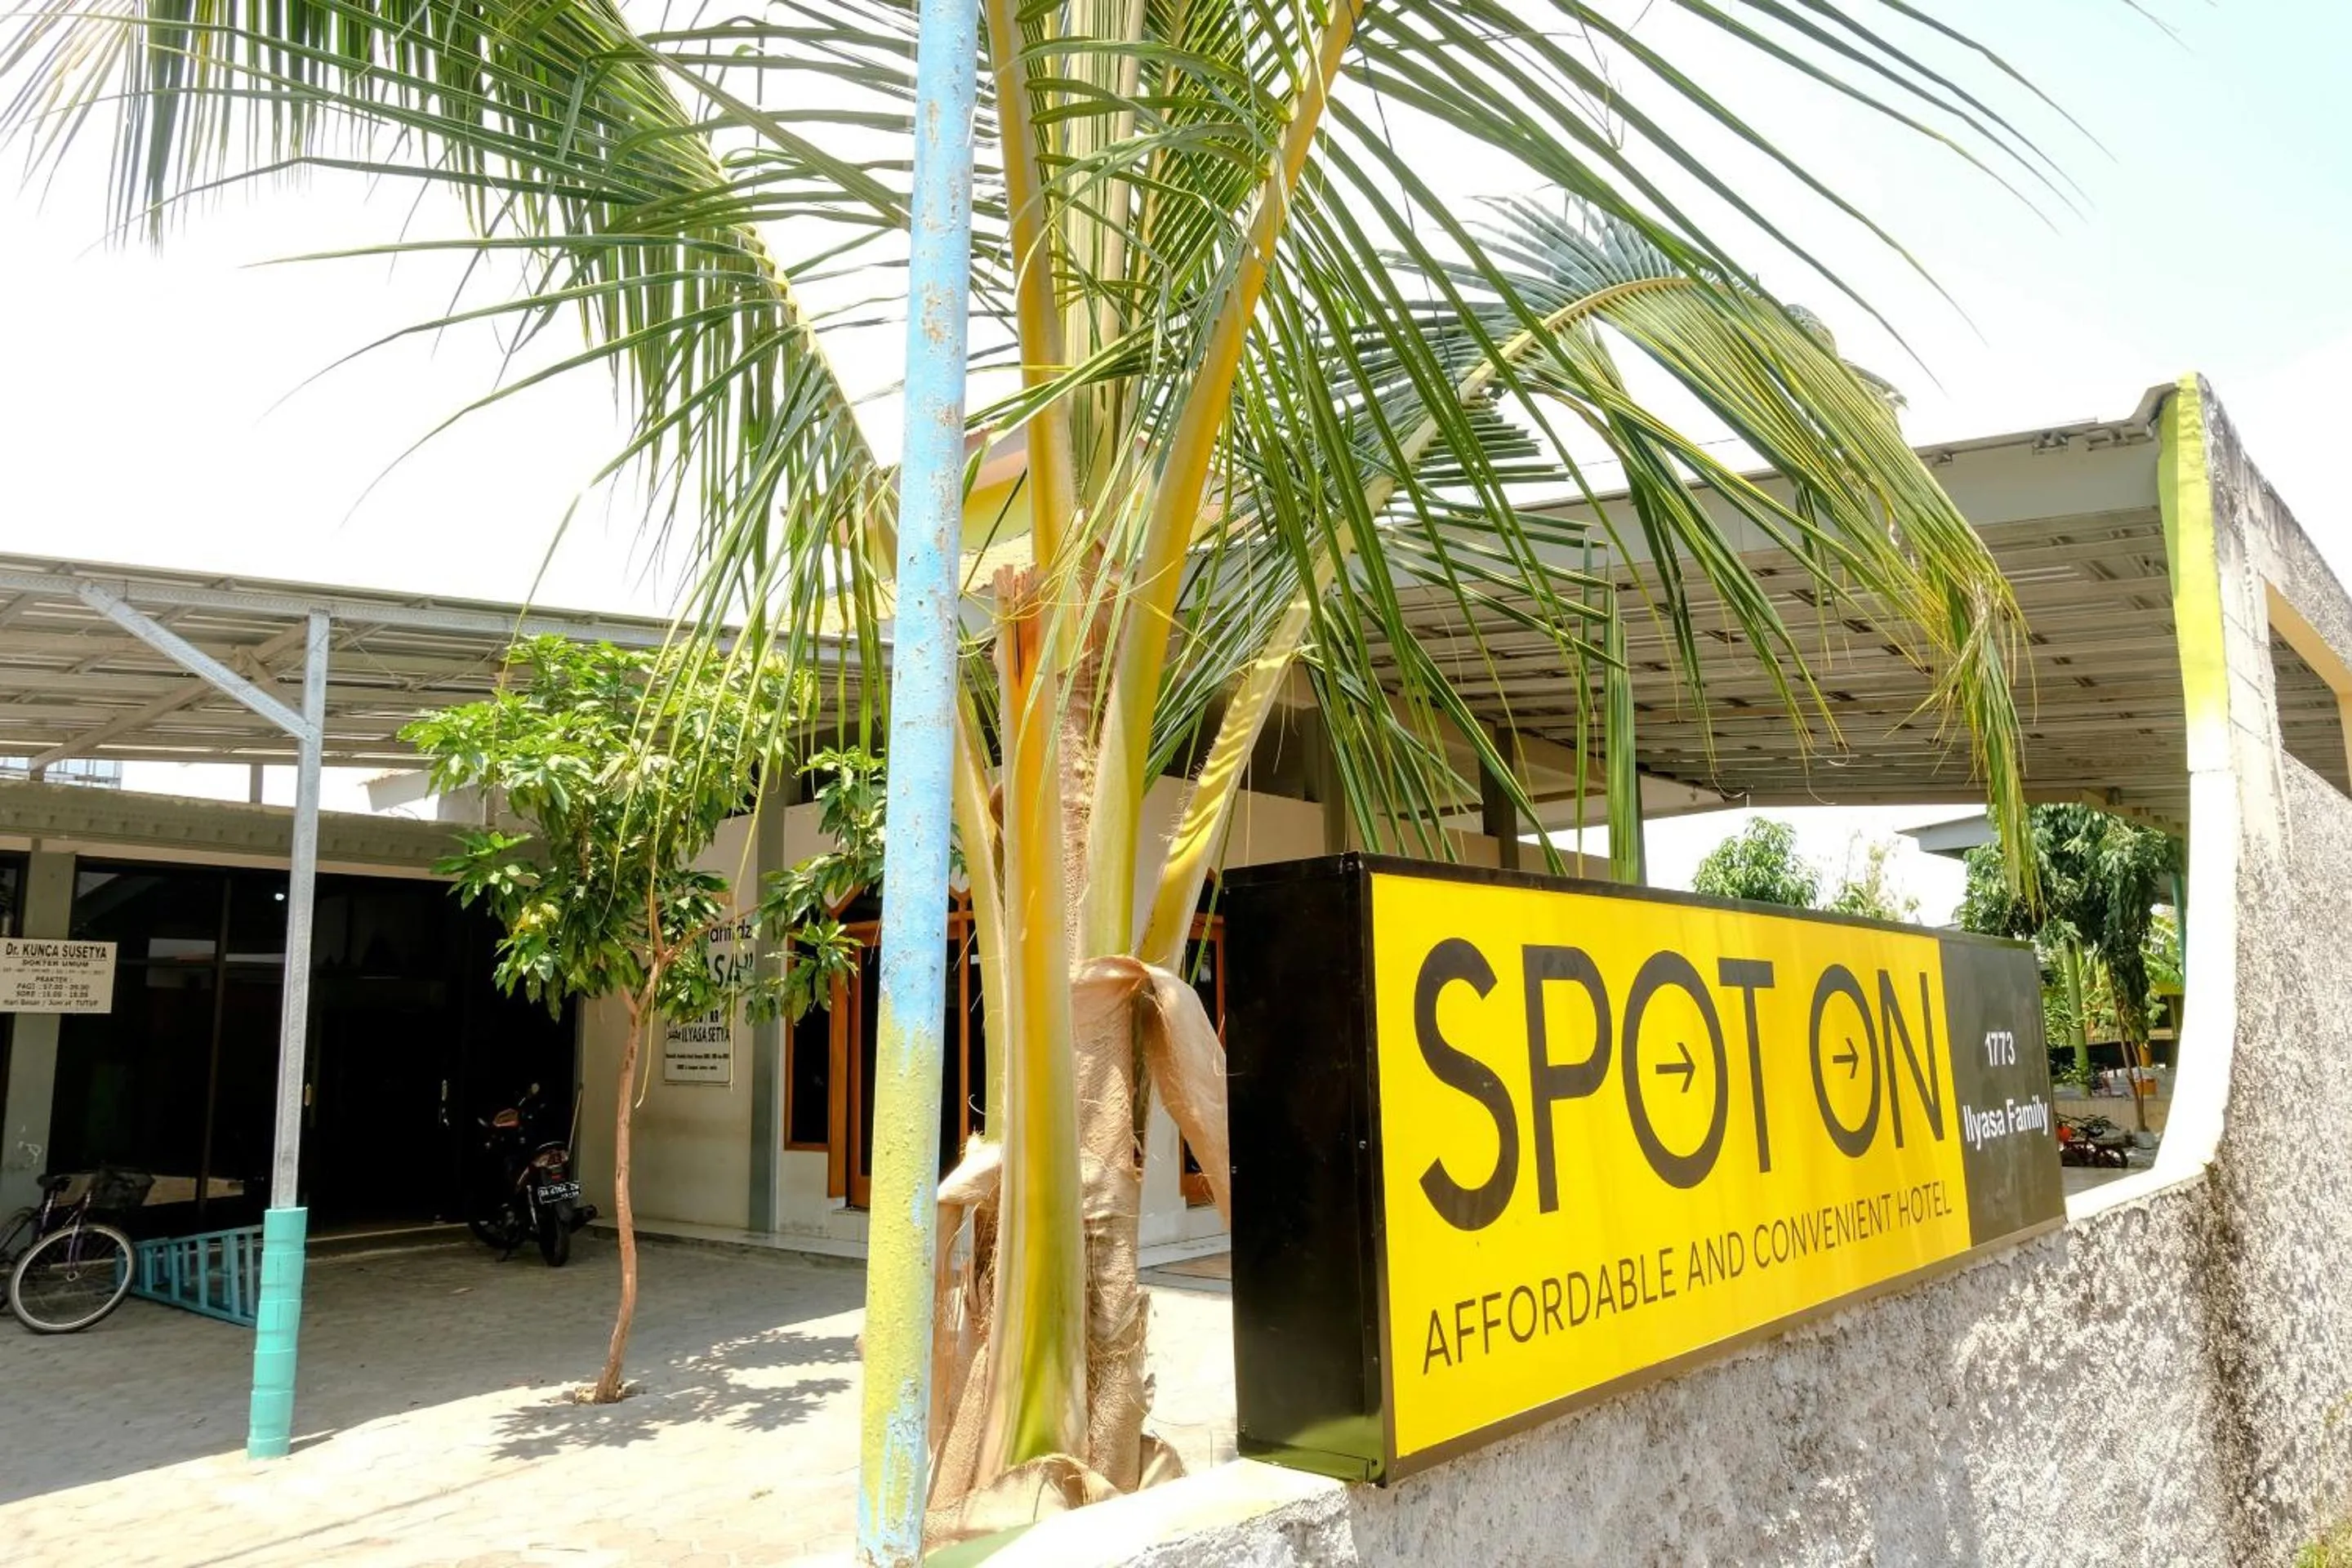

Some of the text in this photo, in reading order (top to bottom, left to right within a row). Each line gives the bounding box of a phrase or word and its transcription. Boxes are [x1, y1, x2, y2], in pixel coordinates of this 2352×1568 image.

[6, 942, 107, 958] Dr. KUNCA SUSETYA
[1984, 1031, 2016, 1067] 1773
[1414, 937, 1944, 1232] SPOT ON
[1962, 1094, 2047, 1152] Ilyasa Family
[1423, 1180, 1953, 1374] AFFORDABLE AND CONVENIENT HOTEL
